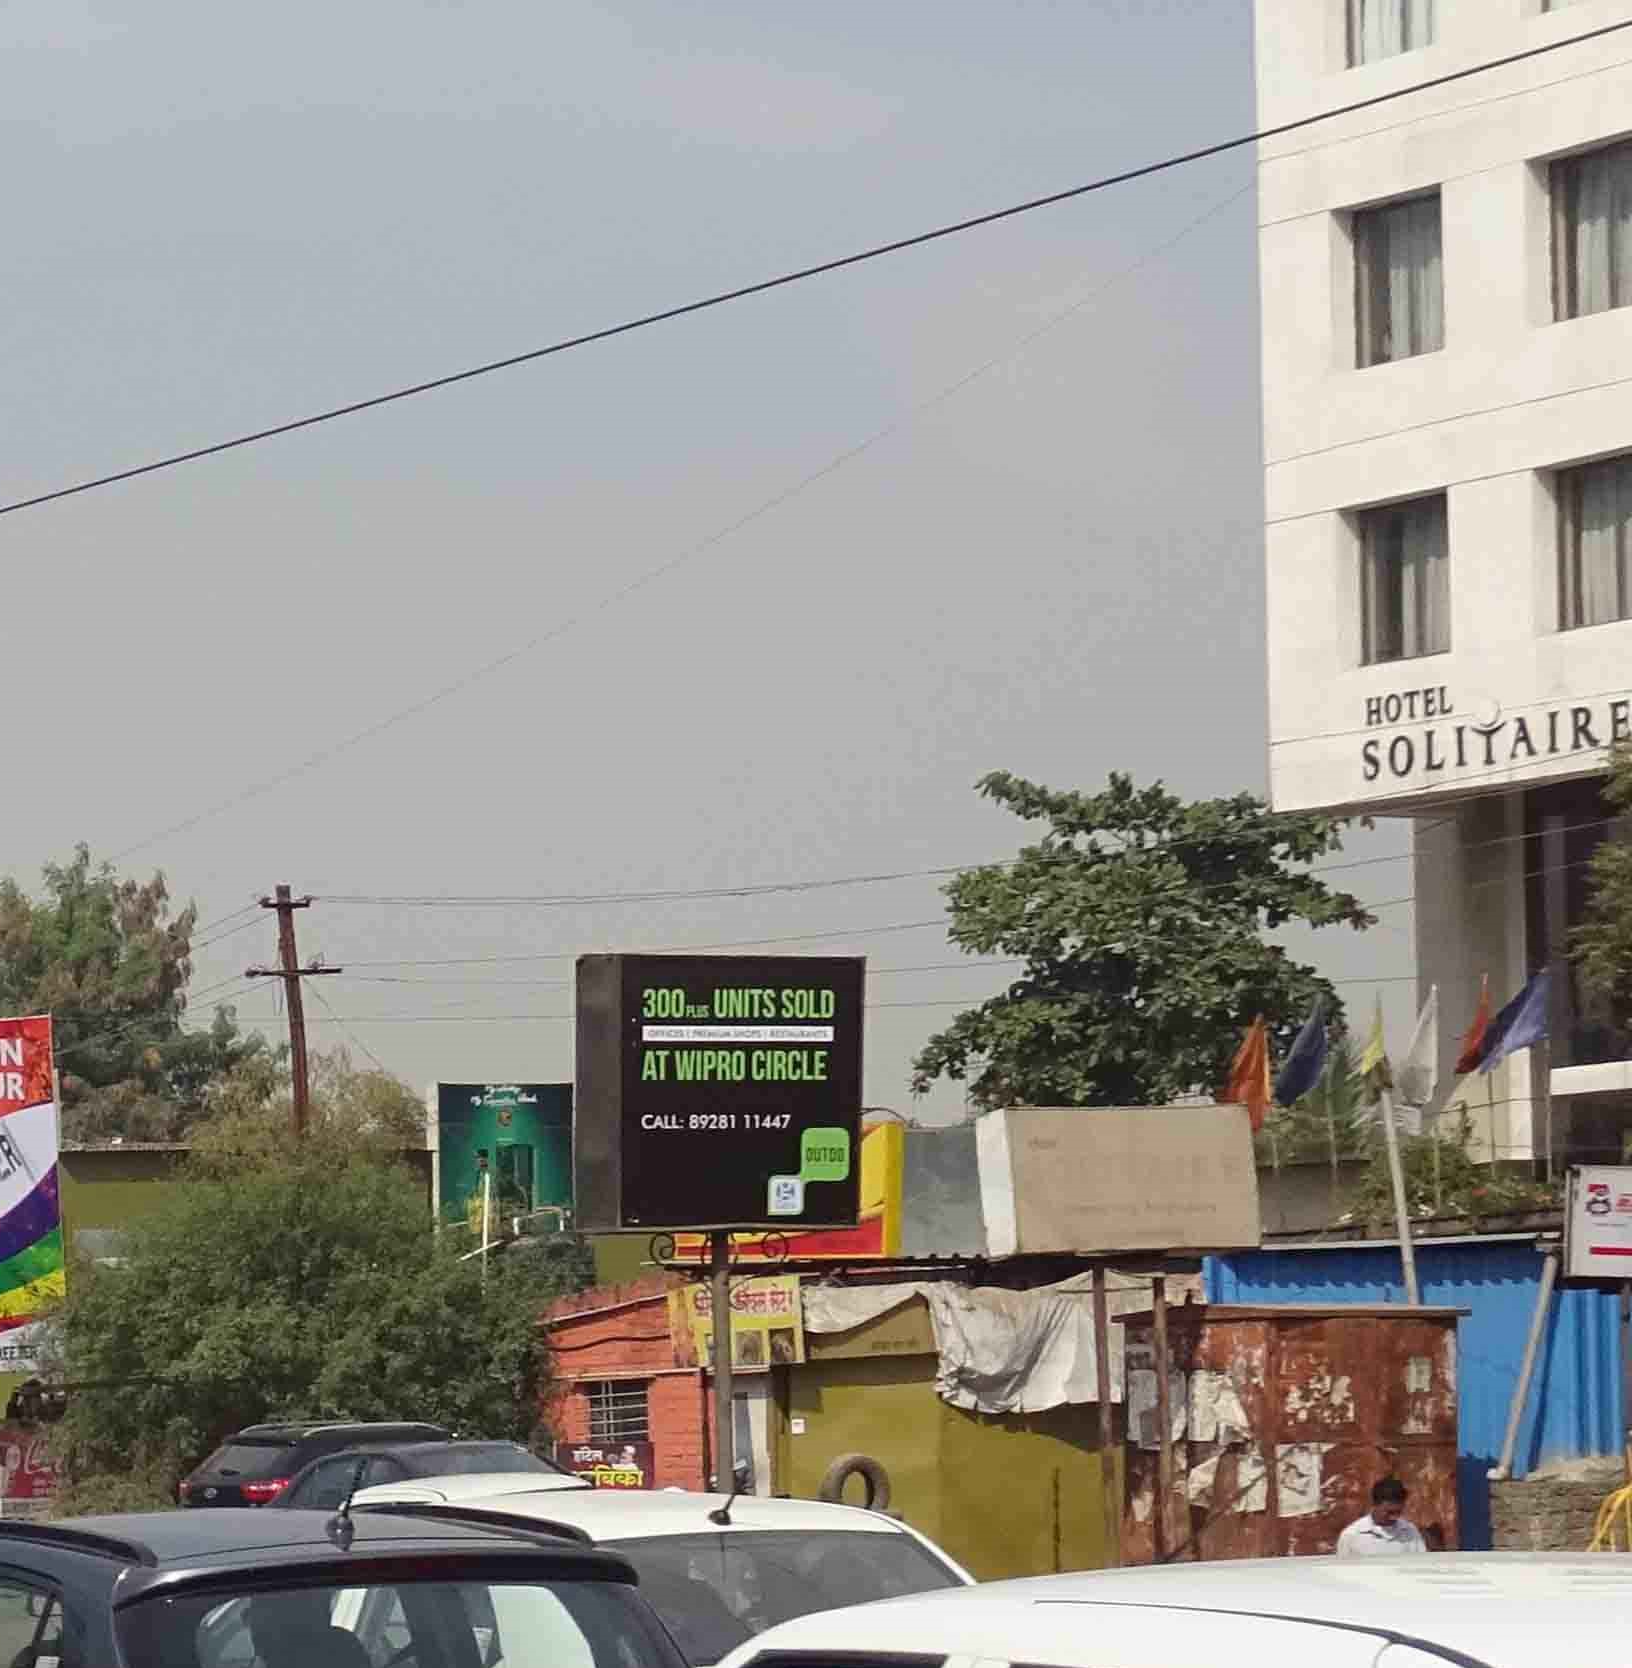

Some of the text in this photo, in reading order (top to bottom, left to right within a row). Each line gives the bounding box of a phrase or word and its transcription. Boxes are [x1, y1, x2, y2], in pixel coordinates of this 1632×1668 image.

[1365, 685, 1453, 727] HOTEL
[1362, 699, 1632, 781] SOLITAIRE
[642, 988, 685, 1019] 300
[713, 988, 777, 1019] UNITS
[781, 988, 835, 1019] SOLD
[641, 1050, 828, 1081] AT WIPRO CIRCLE
[640, 1114, 792, 1129] CALL: 89281 11447
